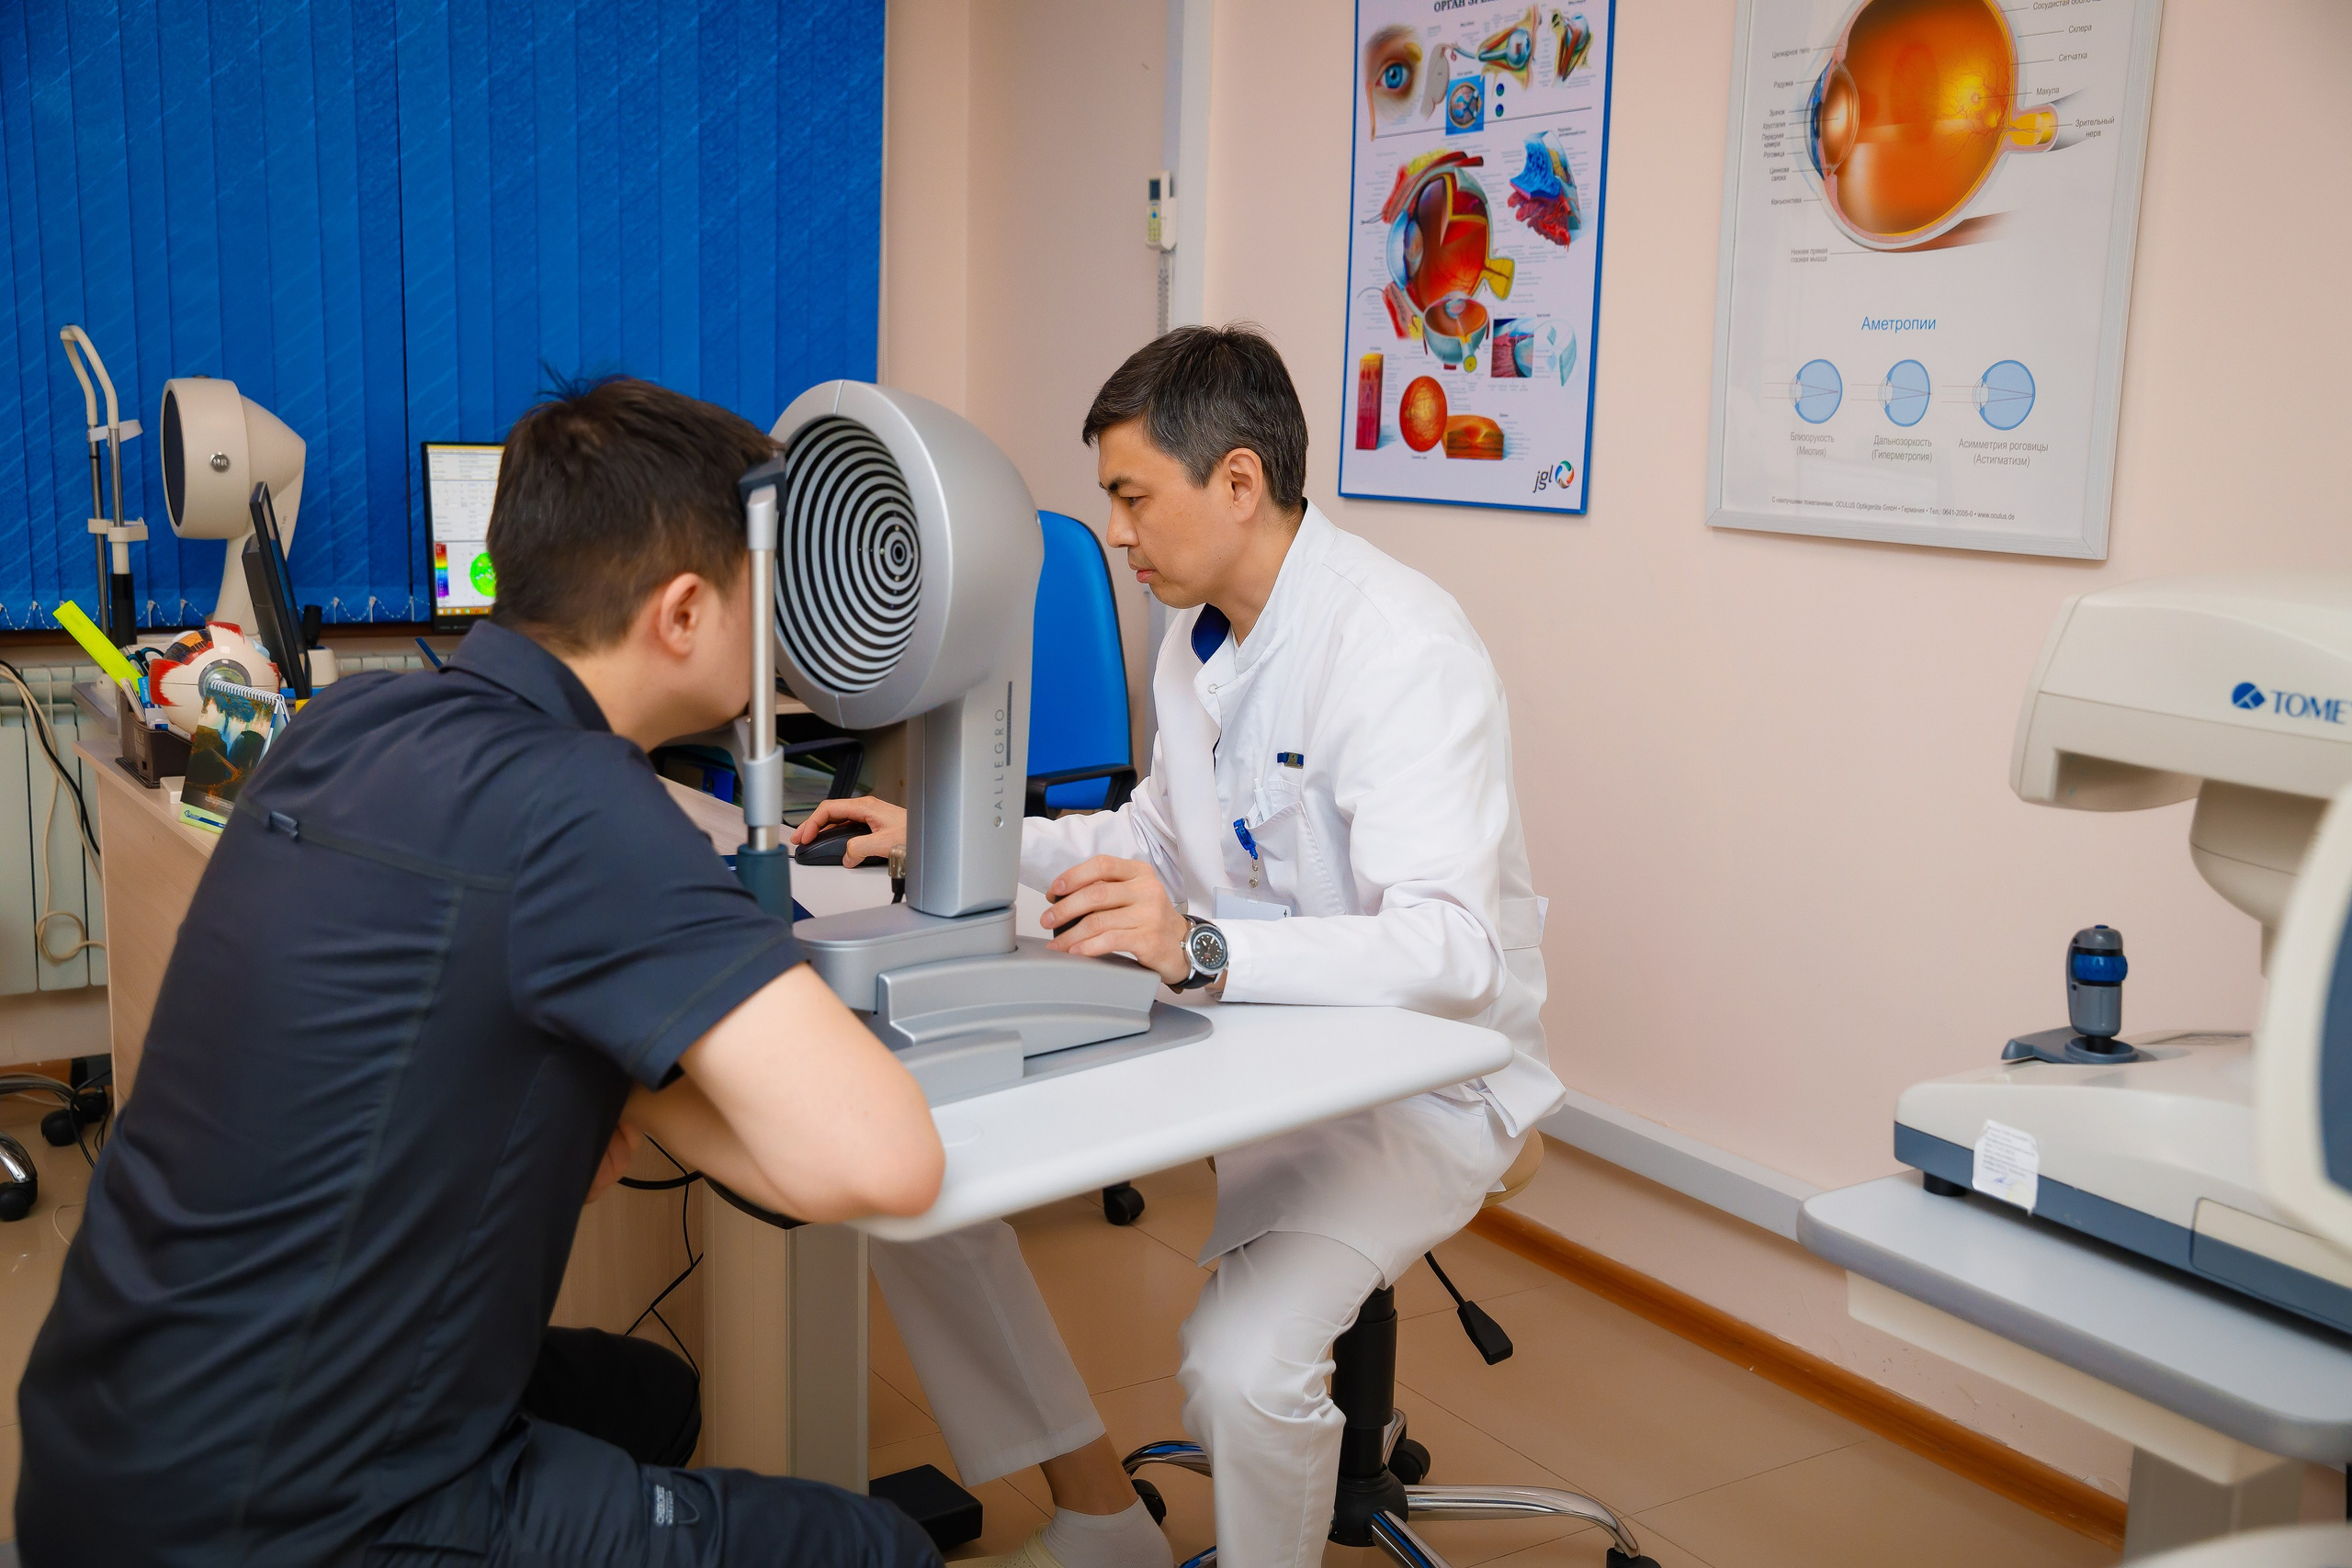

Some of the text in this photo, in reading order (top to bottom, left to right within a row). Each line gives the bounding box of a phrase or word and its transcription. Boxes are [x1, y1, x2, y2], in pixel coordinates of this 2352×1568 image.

[1434, 0, 1465, 12] ОРГАН
[2033, 0, 2070, 10] Сосудистая
[2068, 24, 2093, 34] Склера
[2058, 52, 2088, 62] Сетчатка
[2036, 86, 2060, 96] Макула
[2075, 116, 2115, 129] Зрительный
[2086, 130, 2101, 139] нерв
[1860, 316, 1937, 333] Аметропии
[1790, 432, 1835, 444] Близорукость
[1873, 434, 1932, 447] Дальнозоркость
[1796, 446, 1826, 458] (Миопия)
[1958, 438, 2049, 453] Асимметрия роговицы
[1871, 449, 1933, 463] (Гиперметропия)
[1973, 453, 2030, 468] (Астигматизм)
[1532, 464, 1554, 493] jgl
[1835, 501, 1855, 509] OCULUS
[1882, 503, 1897, 512] GmbH
[1977, 511, 2015, 520] www.oculus.de
[2270, 690, 2352, 726] TOME
[994, 708, 1005, 810] ALLEGRO
